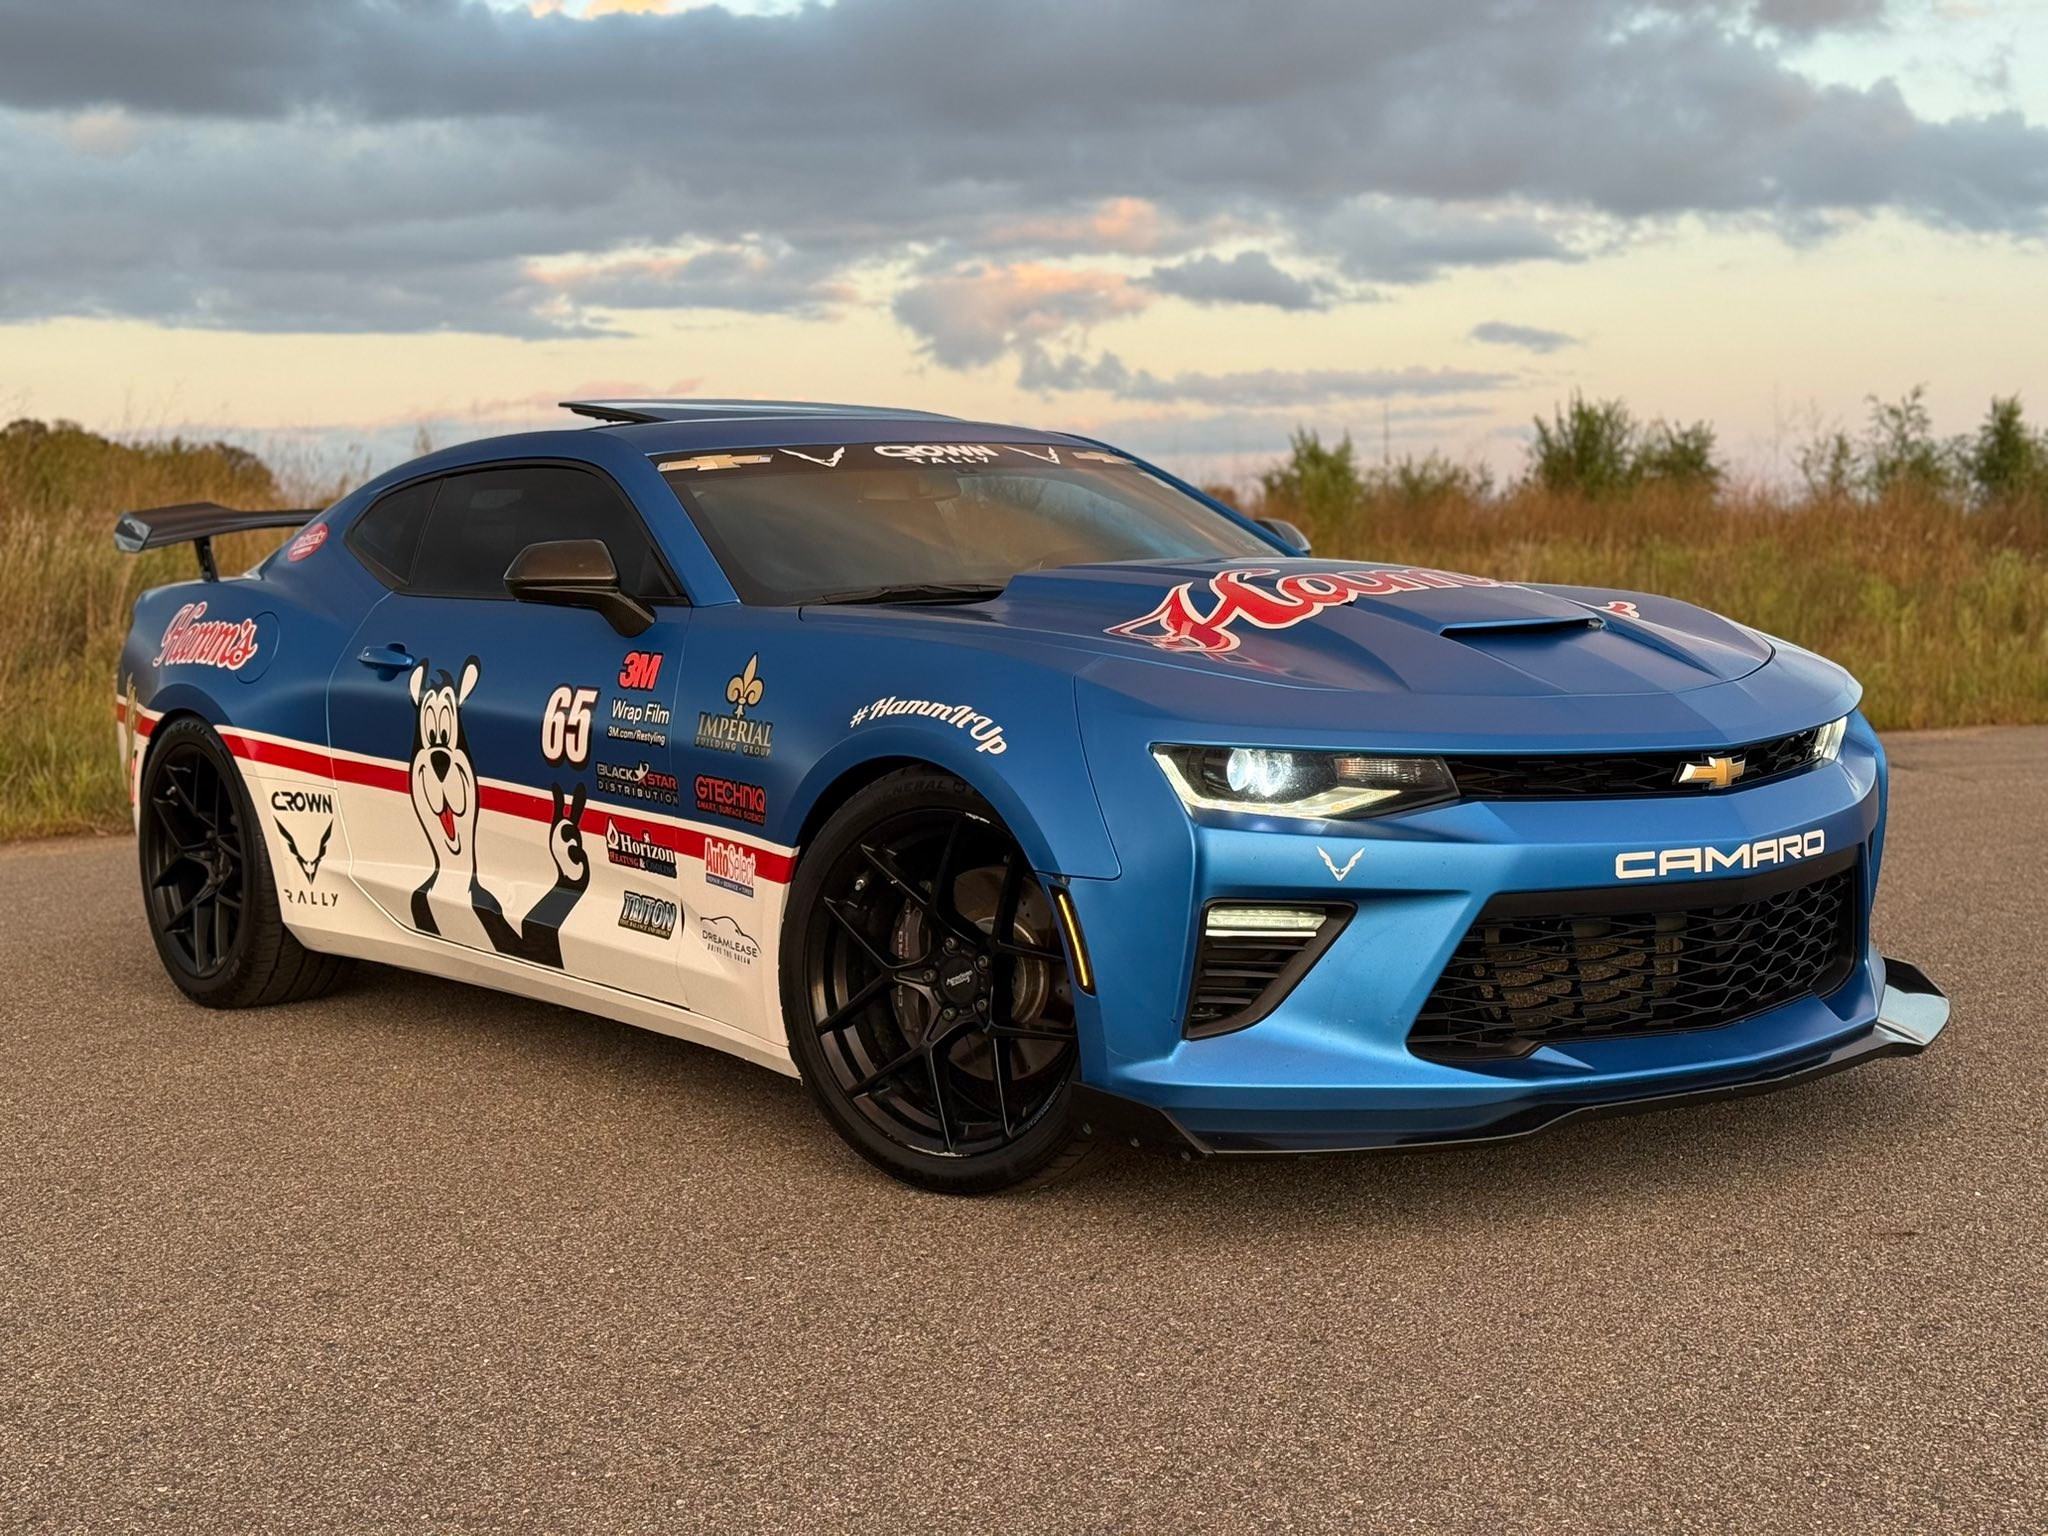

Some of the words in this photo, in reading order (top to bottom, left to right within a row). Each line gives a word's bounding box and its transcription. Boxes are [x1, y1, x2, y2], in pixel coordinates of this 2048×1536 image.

[873, 444, 1000, 457] CROWN
[904, 456, 990, 464] RALLY
[152, 601, 258, 671] Hamm's
[618, 651, 663, 690] 3M
[541, 685, 600, 765] 65
[612, 698, 642, 724] Wrap
[644, 703, 670, 724] Film
[607, 725, 666, 747] 3M.com/Restyling
[697, 713, 773, 747] IMPERIAL
[850, 696, 1008, 755] #HammItUp
[695, 736, 737, 751] BUILDING
[742, 744, 771, 757] GROUP
[596, 763, 633, 782] BLACK
[647, 773, 677, 790] STAR
[271, 791, 333, 814] CROWN
[598, 781, 679, 804] DISTRIBUTION
[695, 775, 766, 813] GTECHNIQ
[619, 832, 675, 863] Horizon
[1615, 829, 1825, 879] CAMARO
[639, 857, 646, 869] &
[705, 838, 755, 887] AutoSelect
[284, 889, 339, 907] RALLY
[622, 892, 676, 931] TRITON
[702, 930, 758, 958] DREAMLEASE
